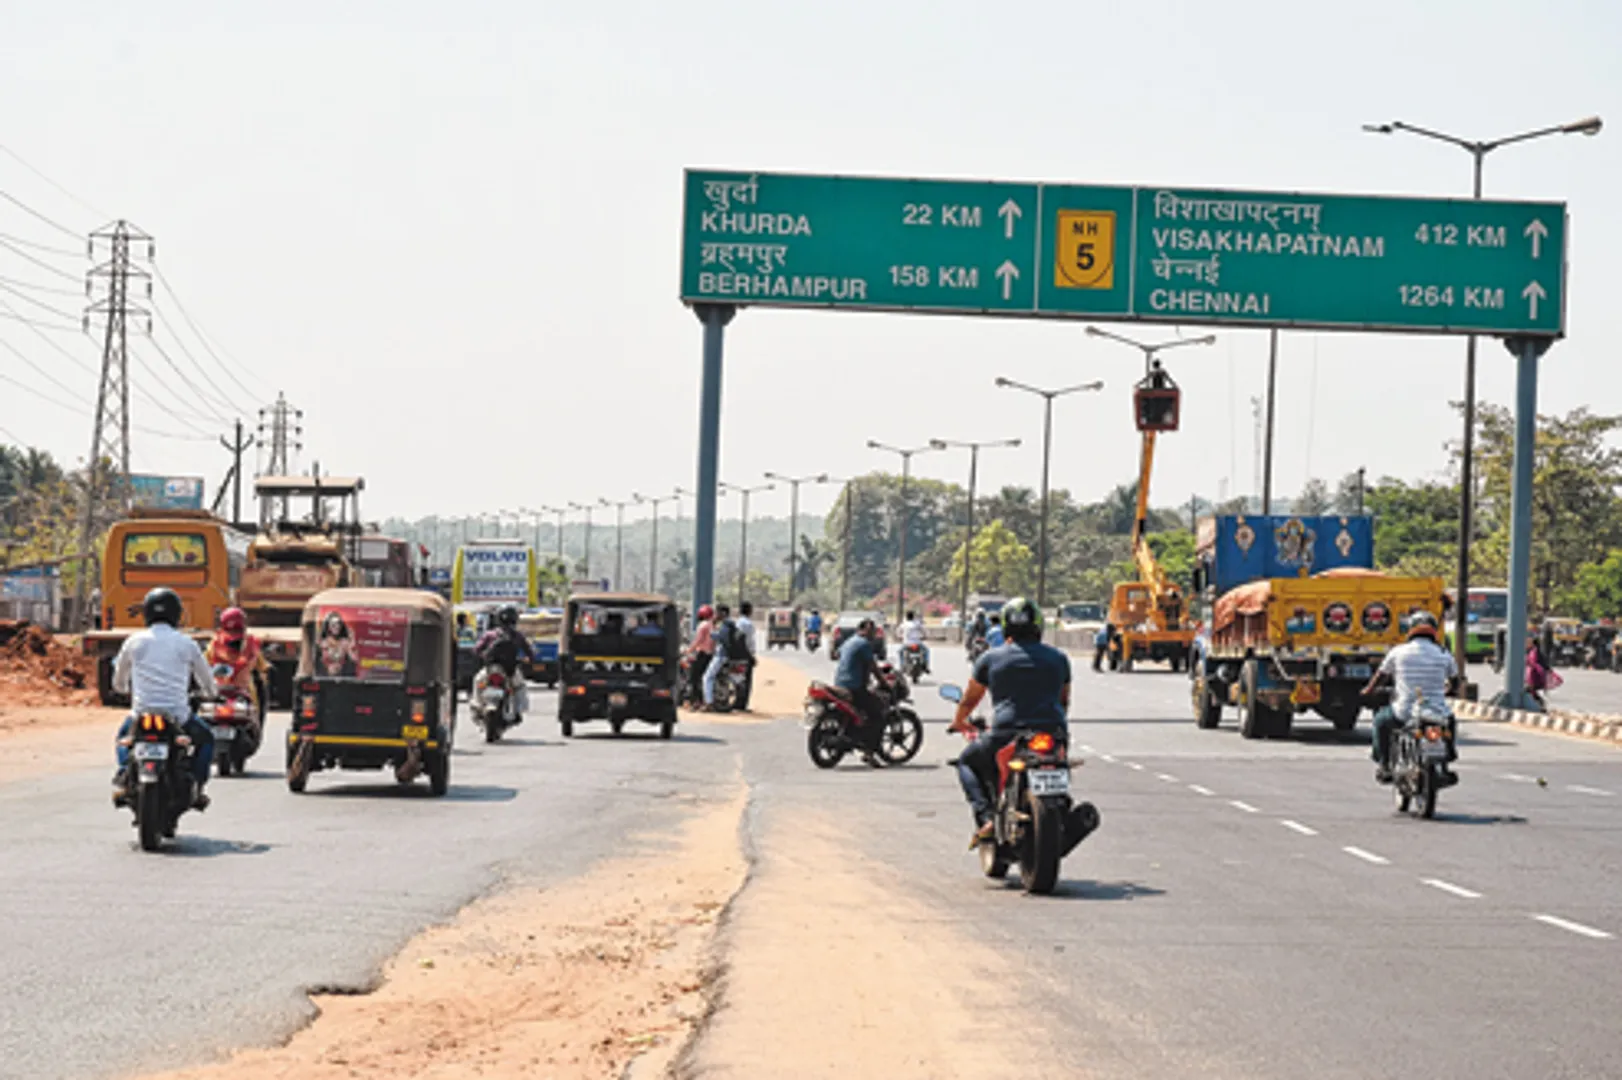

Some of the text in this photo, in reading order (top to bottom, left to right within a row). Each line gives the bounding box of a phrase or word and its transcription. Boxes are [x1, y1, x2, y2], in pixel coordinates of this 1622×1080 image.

[701, 212, 812, 237] KHURDA
[902, 204, 981, 228] 22 KM
[1073, 219, 1098, 236] NH
[1152, 227, 1385, 258] VISAKHAPATNAM
[1415, 222, 1506, 247] 412 KM
[1076, 243, 1095, 270] 5
[1152, 252, 1220, 286] चेन्नई
[699, 272, 867, 300] BERHAMPUR
[889, 265, 979, 288] 158 KM
[1150, 288, 1270, 314] CHENNAI
[1398, 285, 1505, 309] 1264 KM
[465, 550, 527, 563] VOLVO
